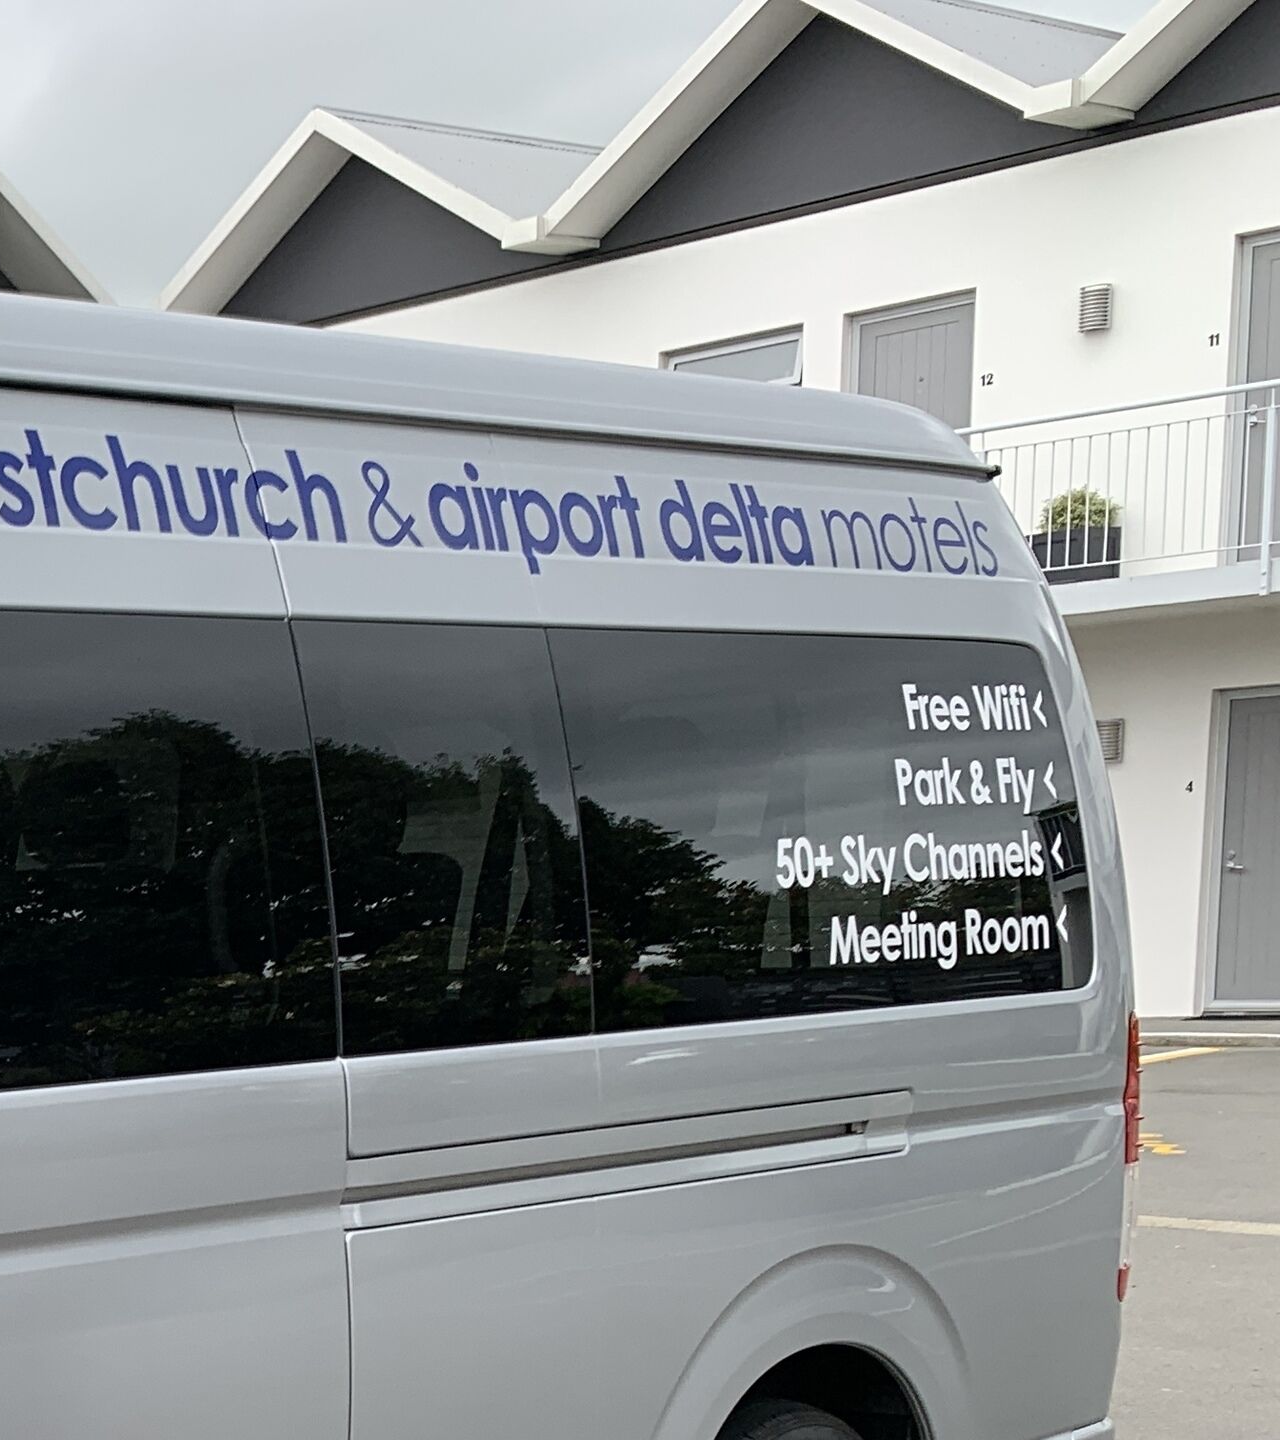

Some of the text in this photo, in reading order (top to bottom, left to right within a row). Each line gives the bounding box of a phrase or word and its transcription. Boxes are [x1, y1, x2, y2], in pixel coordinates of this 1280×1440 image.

[1208, 333, 1220, 347] 11
[980, 372, 994, 387] 12
[361, 460, 422, 548] &
[428, 462, 645, 575] airport
[658, 479, 814, 566] delta
[820, 497, 999, 577] motels
[902, 683, 1032, 731] Free Wifi
[894, 757, 1035, 815] Park & Fly
[1185, 780, 1194, 793] 4
[776, 830, 1044, 895] 50+ Sky Channels
[829, 908, 1050, 970] Meeting Room
